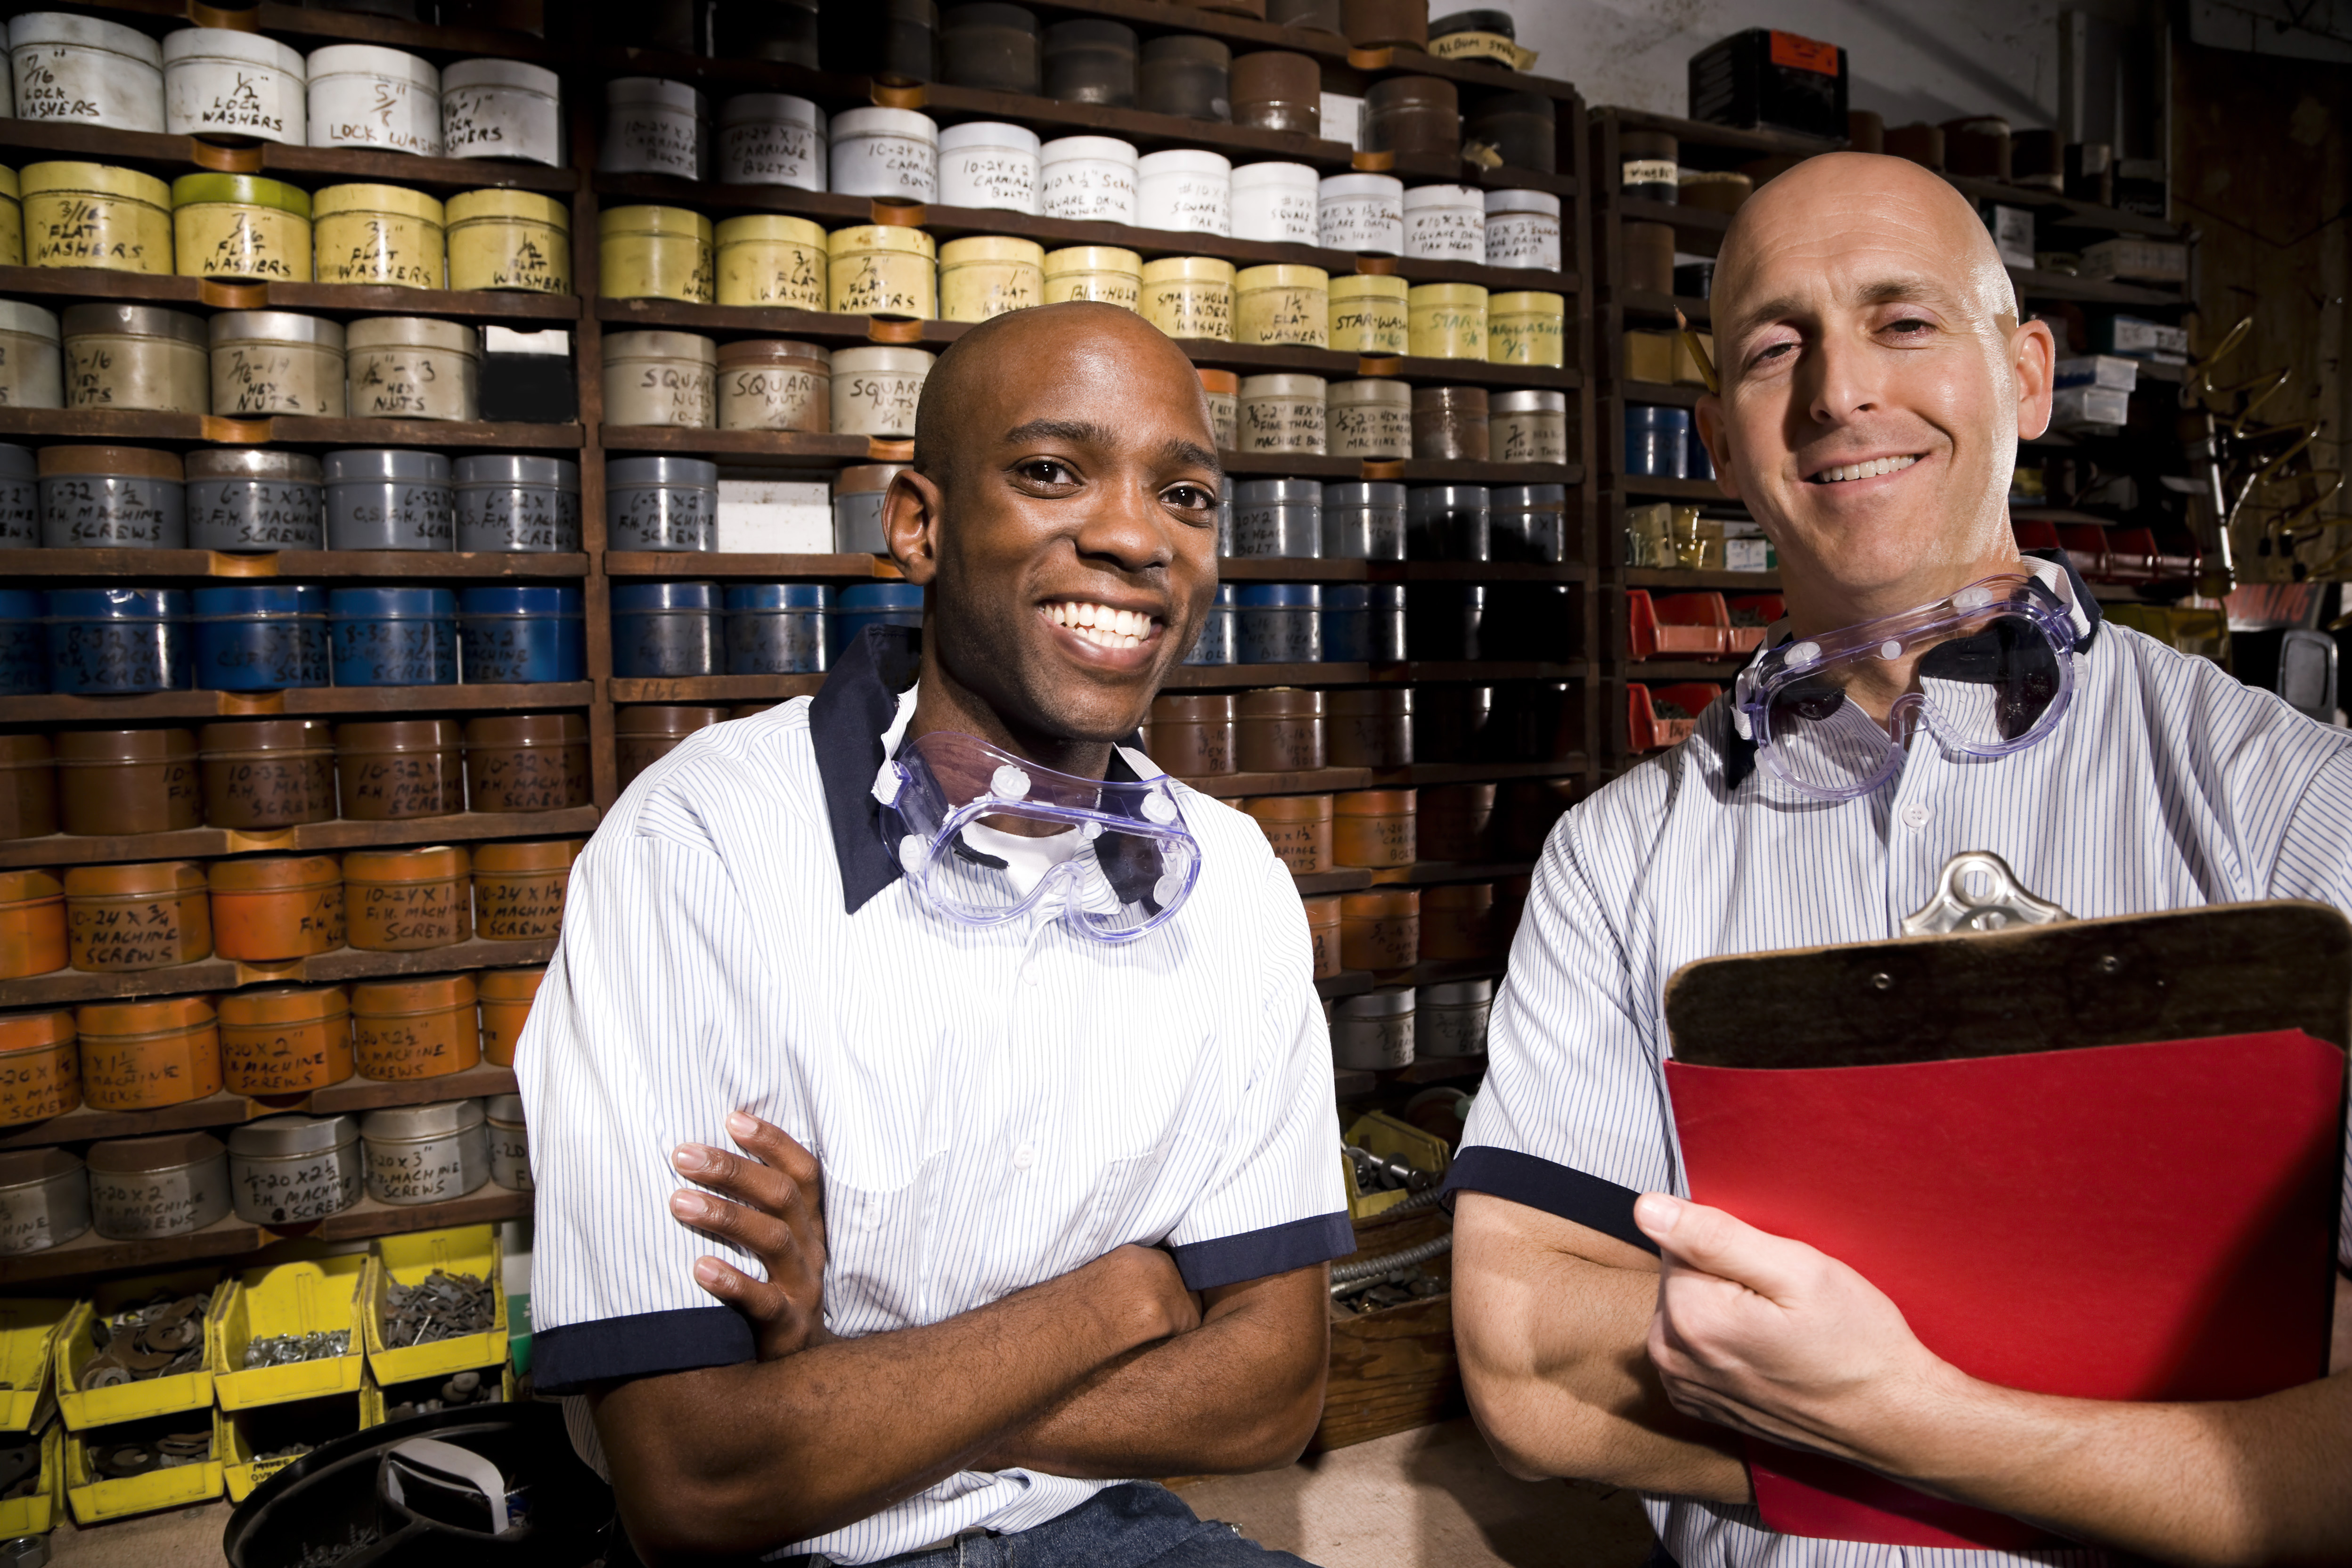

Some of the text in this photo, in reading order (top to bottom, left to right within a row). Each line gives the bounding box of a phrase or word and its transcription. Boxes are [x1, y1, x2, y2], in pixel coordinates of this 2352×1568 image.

[24, 87, 65, 100] LOCK
[214, 97, 261, 112] LOCK
[203, 111, 283, 132] WASHERS
[331, 123, 378, 141] LOCK
[383, 1180, 445, 1199] SCREWS
